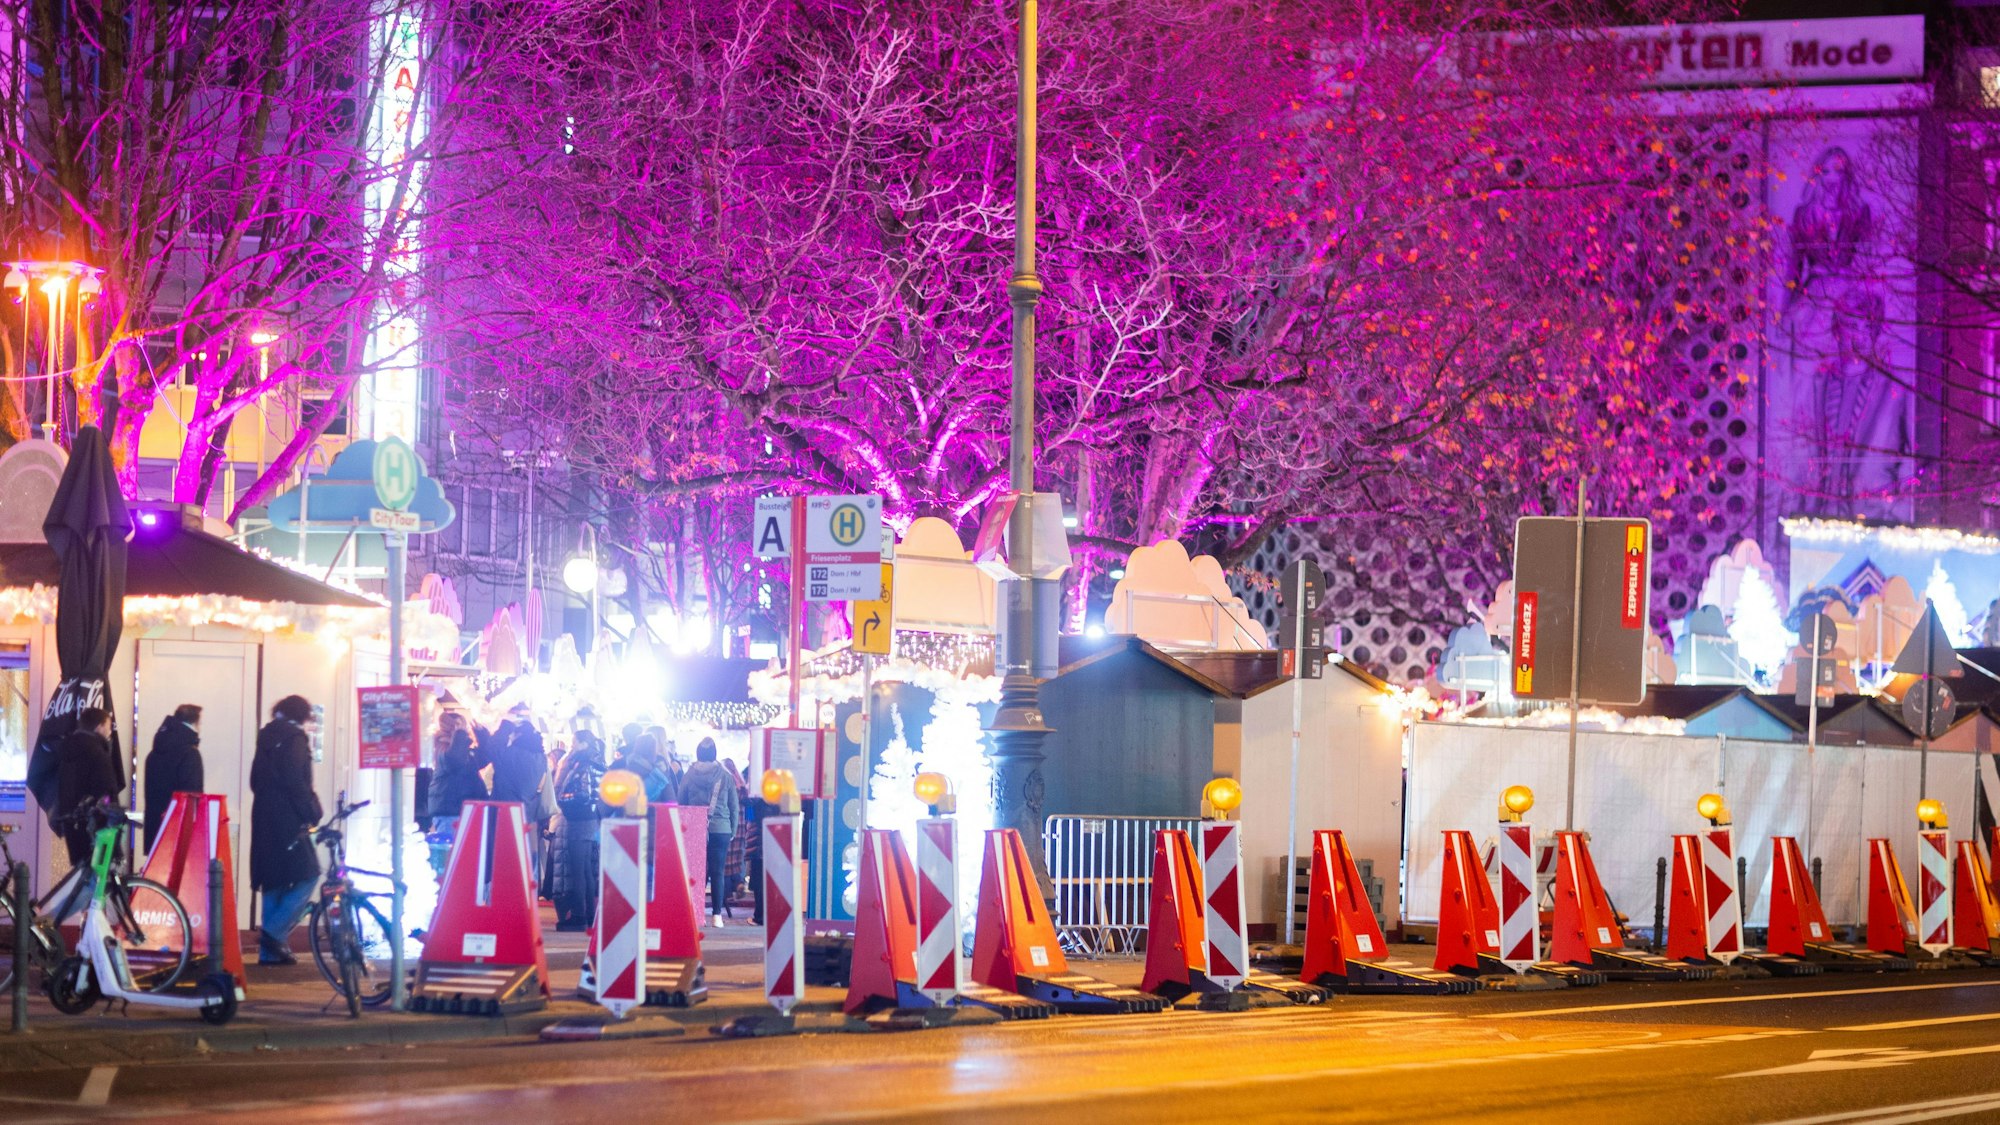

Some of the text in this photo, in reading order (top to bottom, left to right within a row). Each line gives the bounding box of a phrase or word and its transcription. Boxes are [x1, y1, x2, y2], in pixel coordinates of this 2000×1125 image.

[1791, 38, 1893, 66] Mode
[385, 453, 404, 493] H
[375, 511, 416, 526] CityTour
[758, 502, 788, 511] Bussteig
[758, 516, 785, 552] A
[839, 511, 856, 538] H
[811, 554, 852, 563] Friesenplatz
[812, 569, 827, 579] 172
[812, 585, 827, 596] 173
[850, 586, 861, 594] Hbf
[1627, 561, 1638, 618] ZEPPELIN
[1522, 602, 1532, 658] ZEPPELIN
[44, 677, 79, 720] ola
[133, 911, 177, 927] ARMIS
